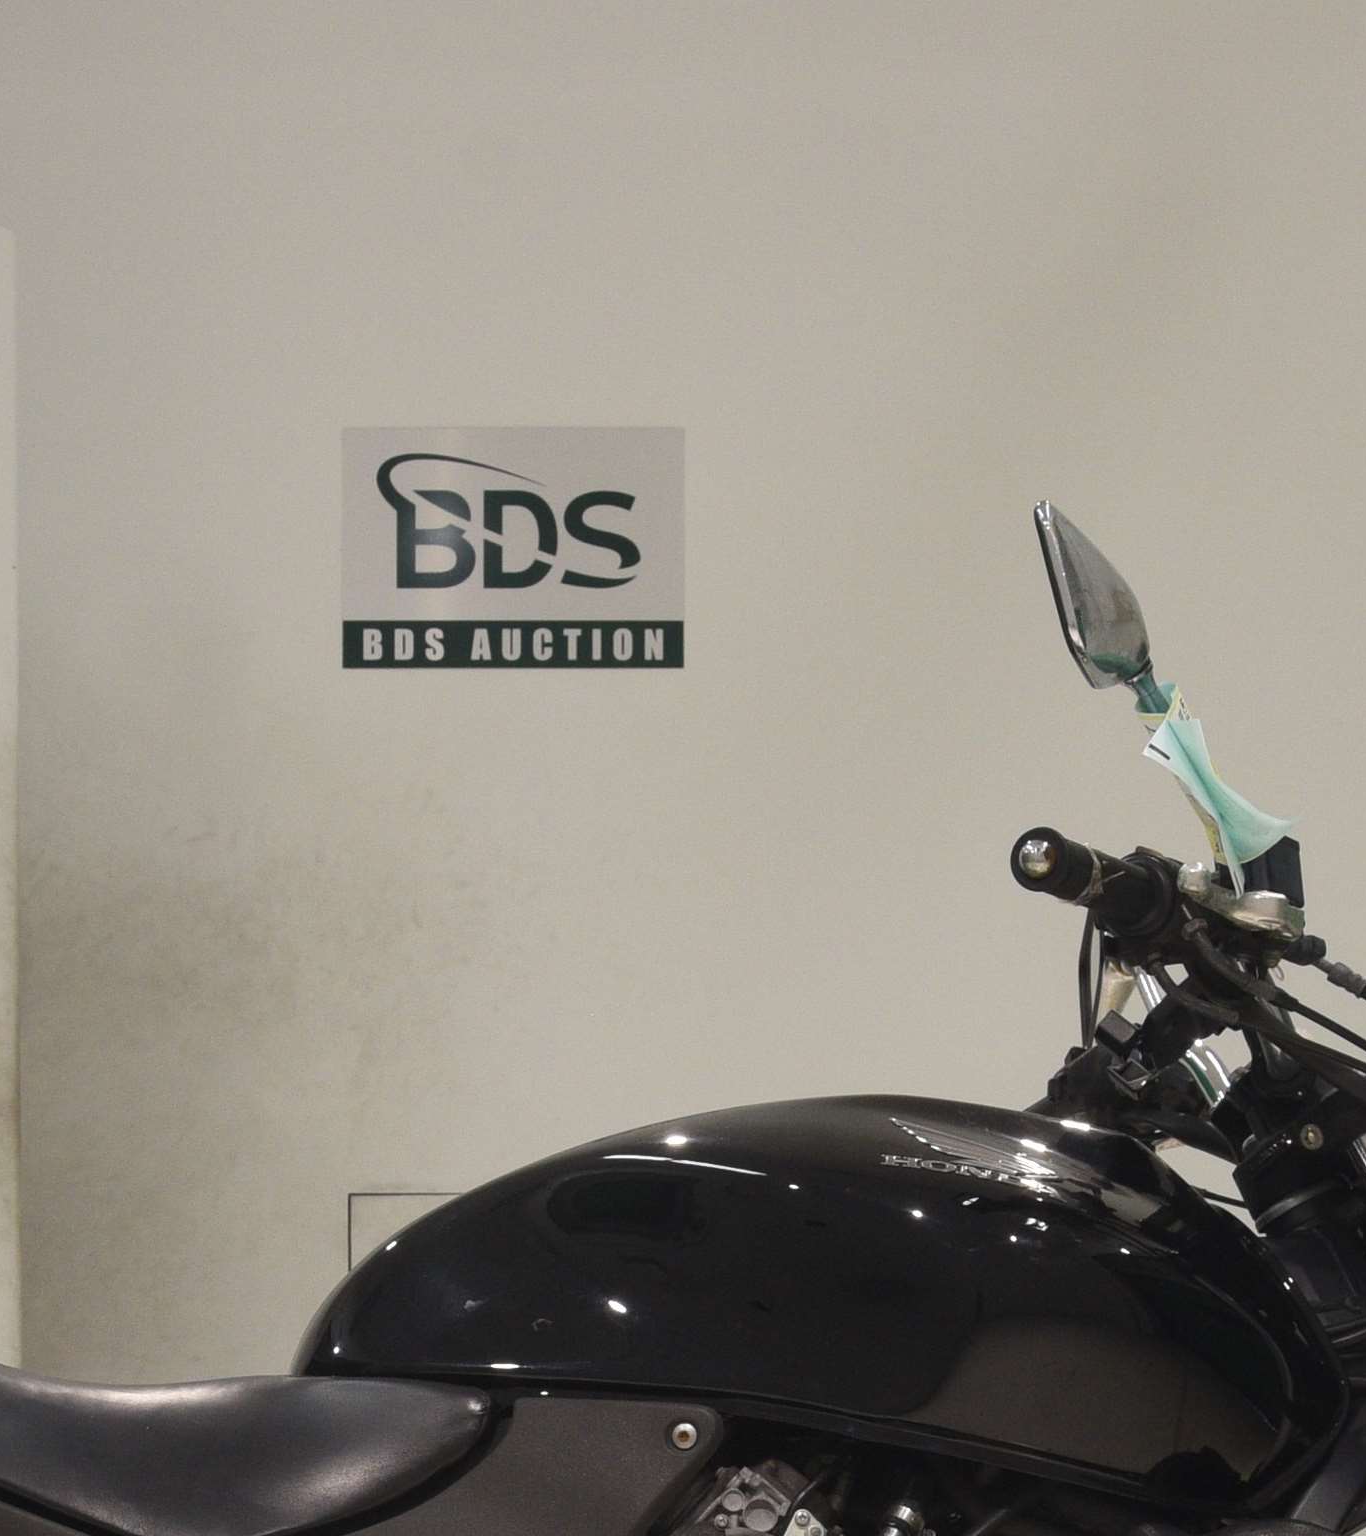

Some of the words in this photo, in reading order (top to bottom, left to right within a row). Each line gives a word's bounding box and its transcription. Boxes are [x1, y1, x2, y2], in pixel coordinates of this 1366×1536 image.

[377, 453, 641, 589] BDS
[362, 628, 445, 661] BDS
[470, 628, 665, 661] AUCTION
